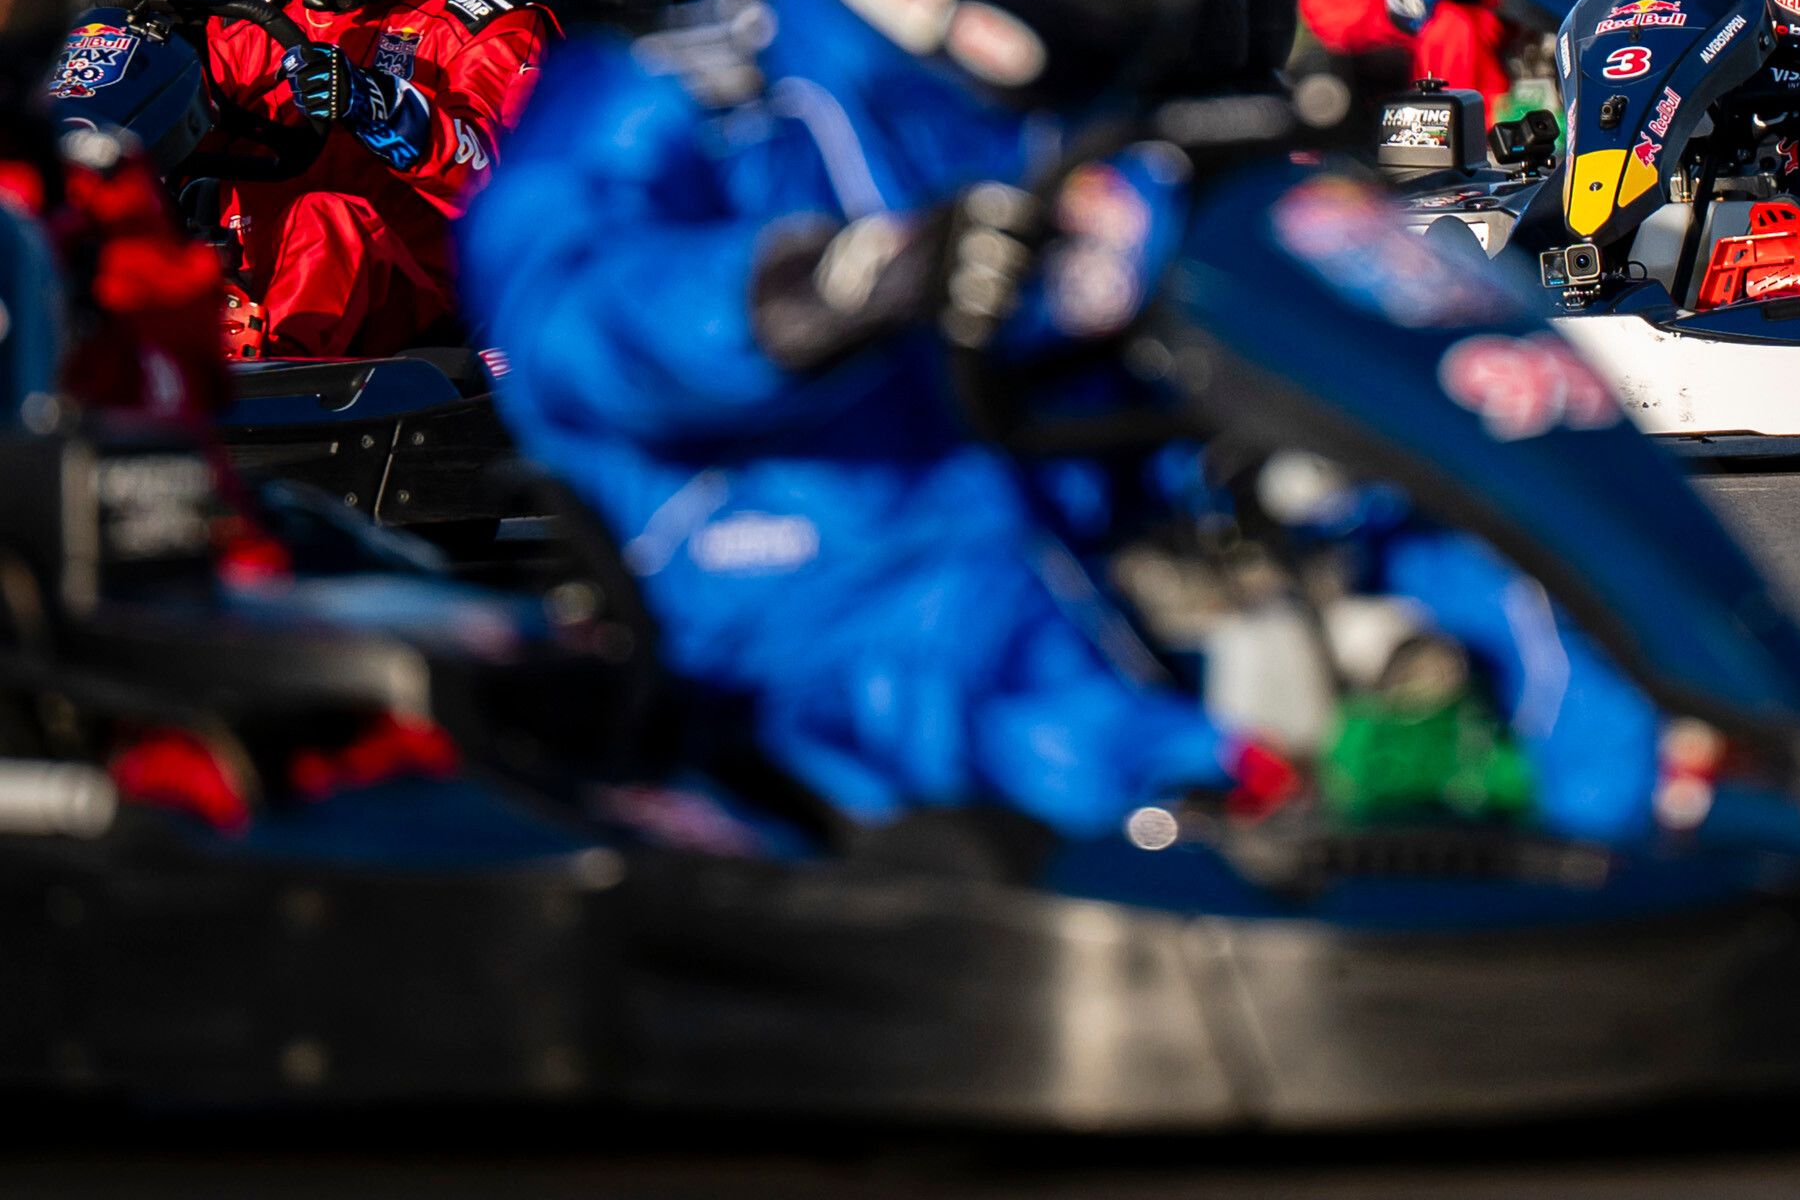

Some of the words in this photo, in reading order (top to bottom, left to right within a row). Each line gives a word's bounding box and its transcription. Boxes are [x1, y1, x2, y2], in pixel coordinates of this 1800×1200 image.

[1595, 13, 1641, 35] Red
[1641, 12, 1687, 28] Bull
[88, 36, 131, 50] Bull
[1603, 46, 1652, 79] 3
